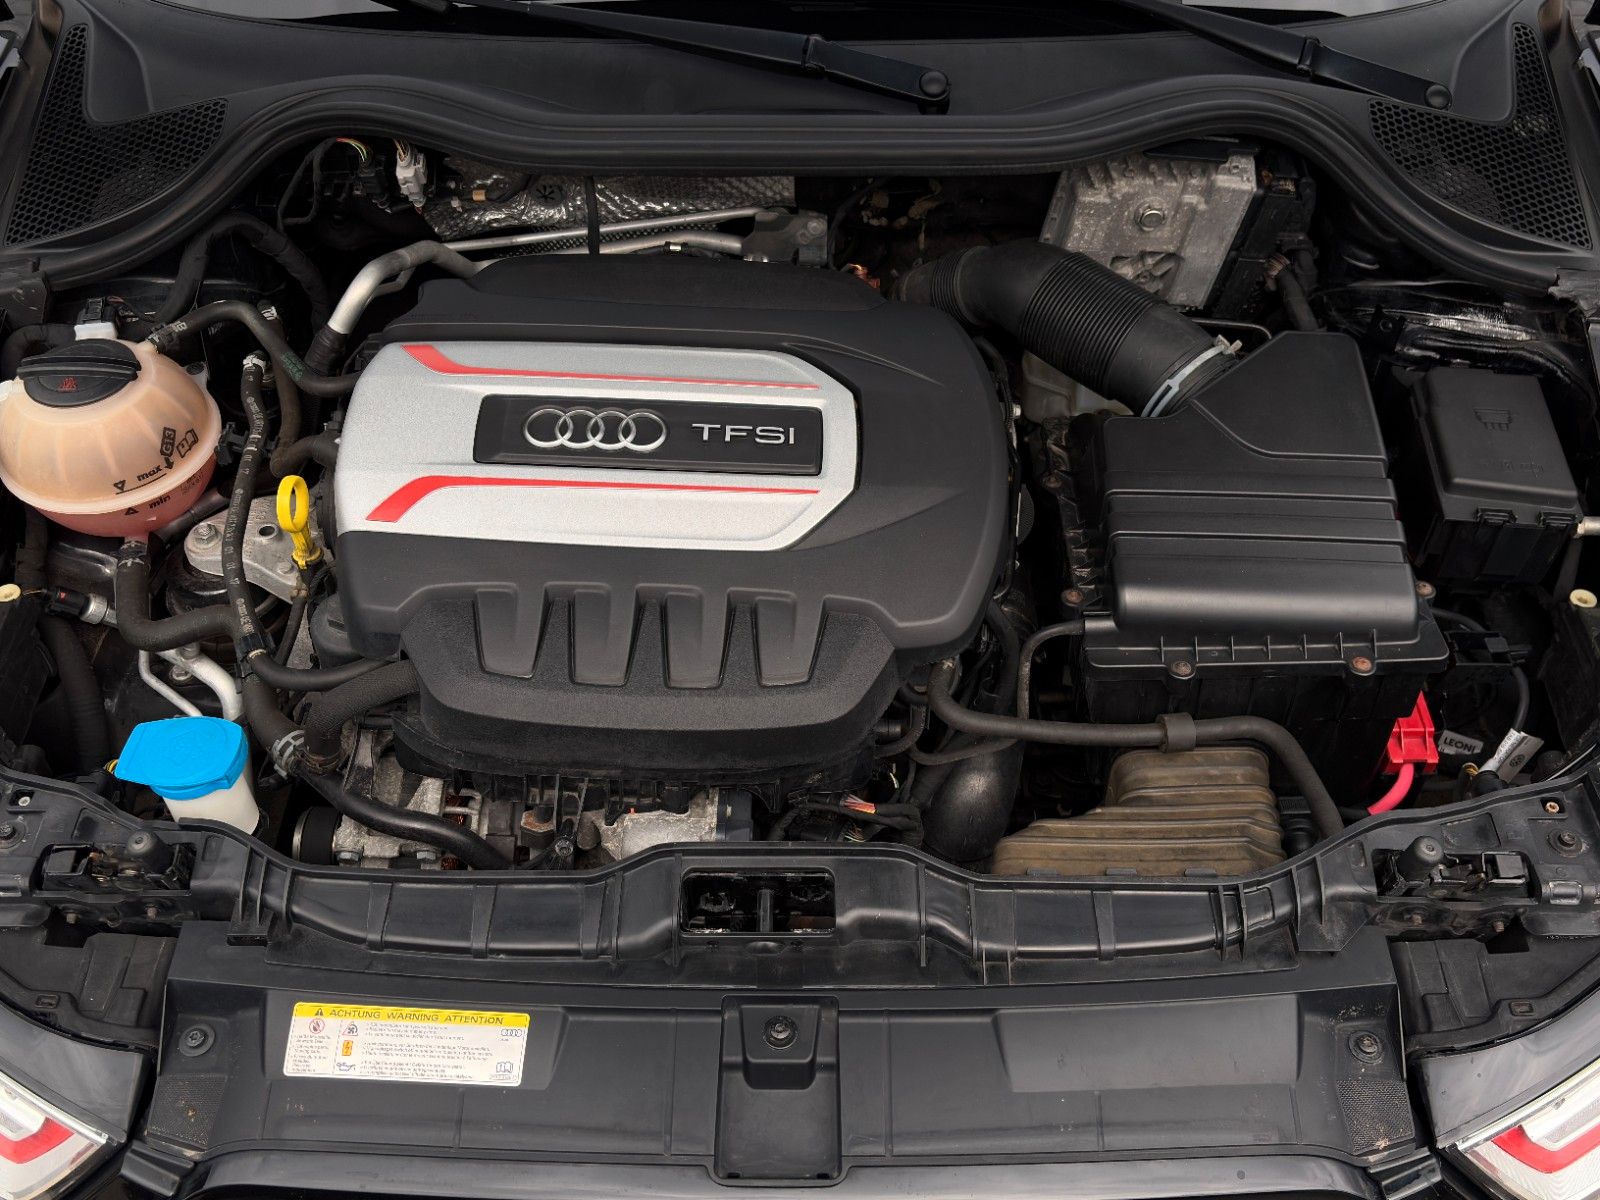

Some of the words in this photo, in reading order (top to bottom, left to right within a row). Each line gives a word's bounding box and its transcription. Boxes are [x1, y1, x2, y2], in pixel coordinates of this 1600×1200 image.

[162, 429, 175, 456] G13
[692, 423, 796, 445] TFSI
[137, 465, 162, 481] max
[149, 495, 171, 509] min
[1443, 736, 1476, 754] LEONI
[329, 1009, 381, 1019] ACHTUNG
[386, 1012, 439, 1022] WARNING
[444, 1014, 505, 1025] ATTENTION
